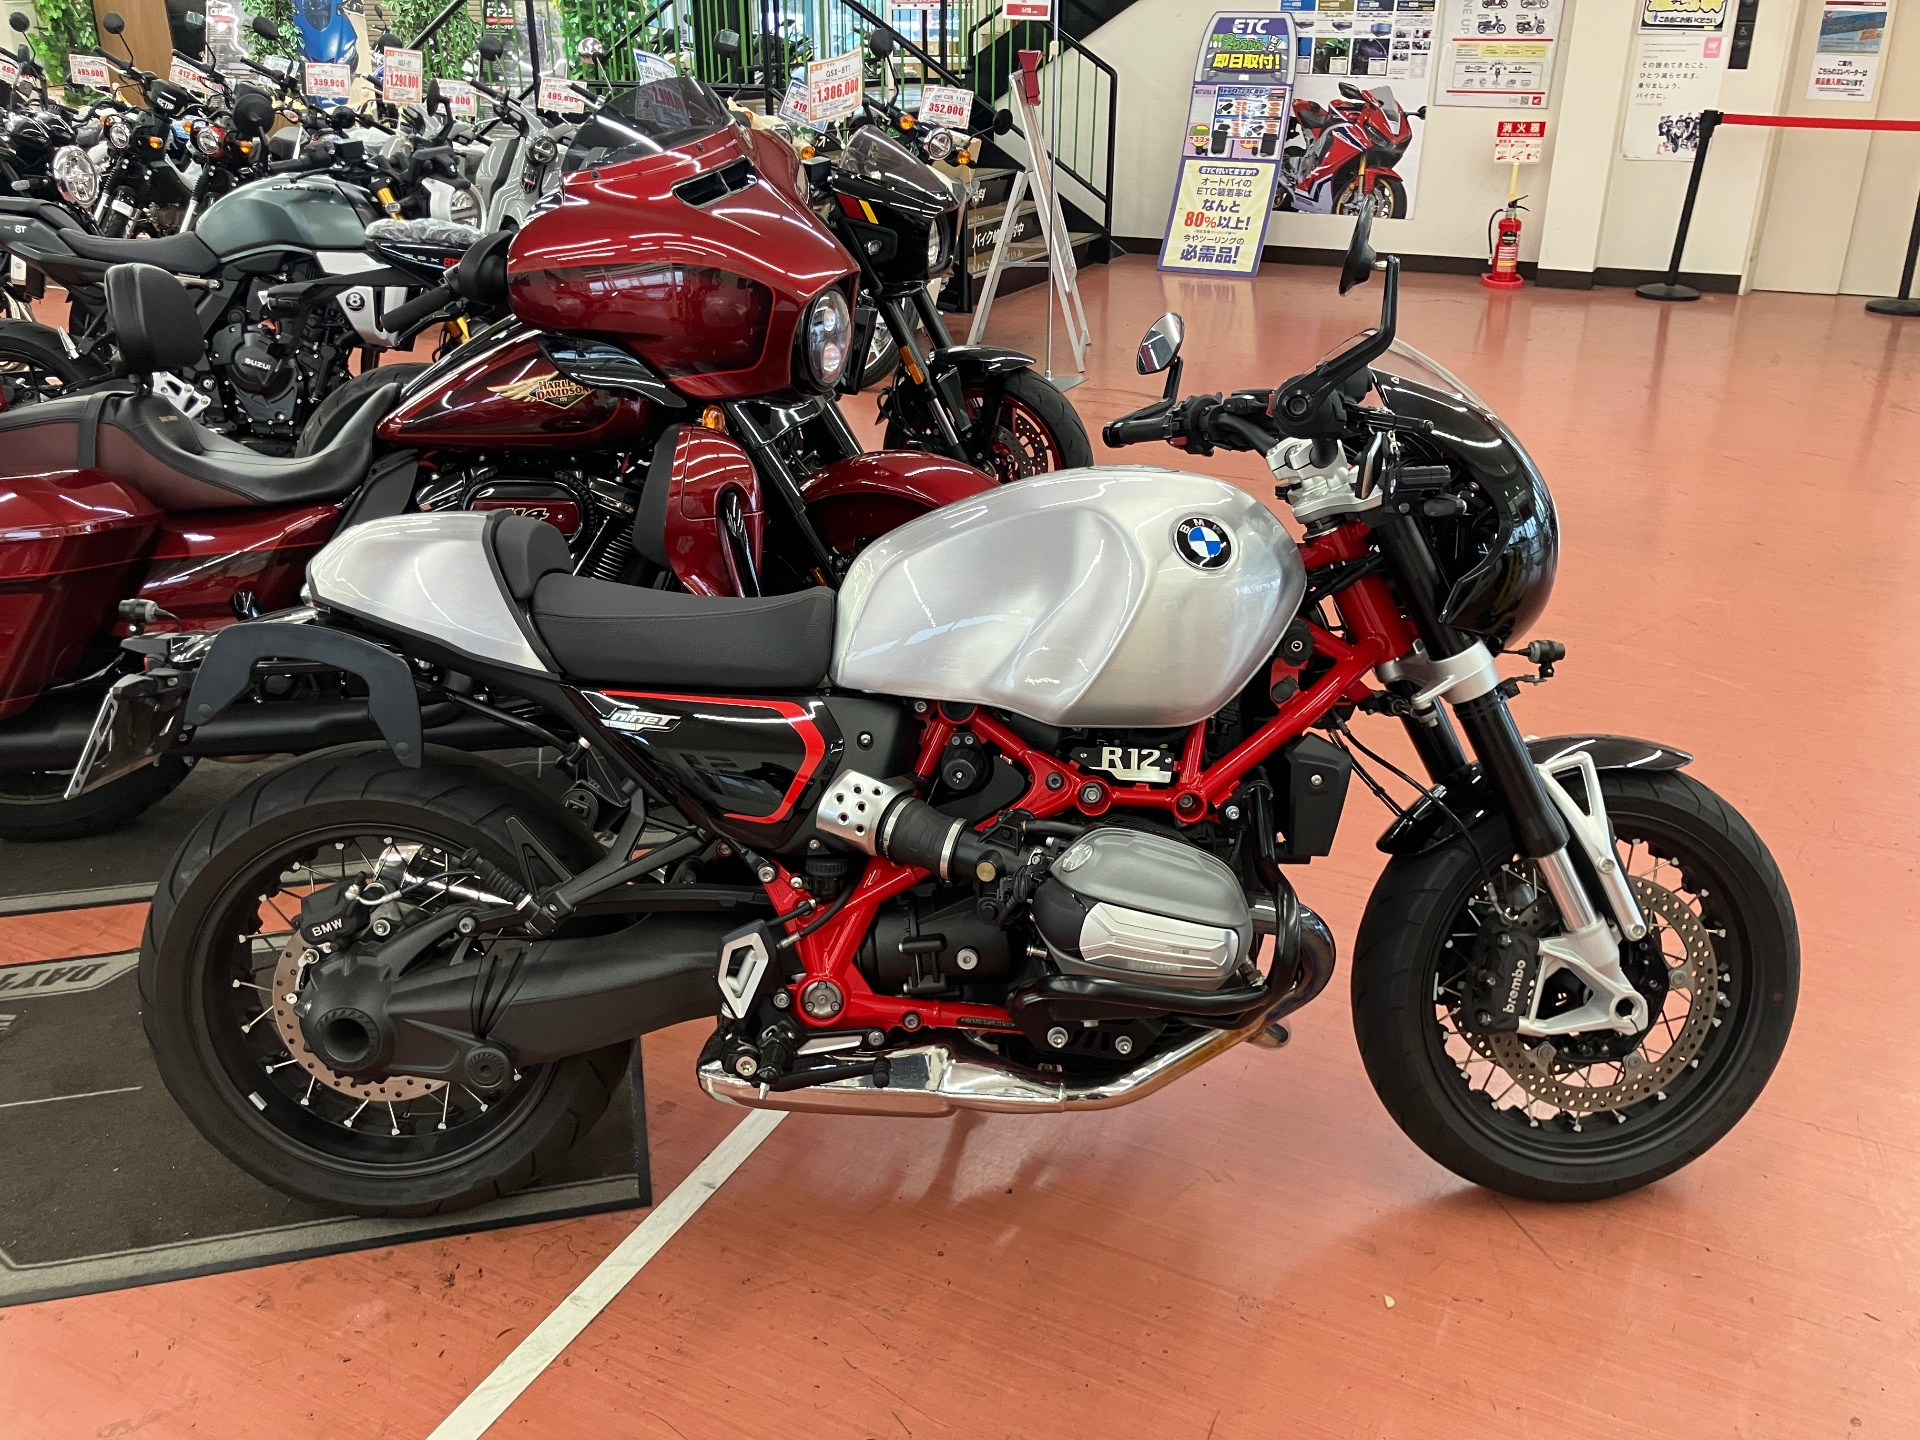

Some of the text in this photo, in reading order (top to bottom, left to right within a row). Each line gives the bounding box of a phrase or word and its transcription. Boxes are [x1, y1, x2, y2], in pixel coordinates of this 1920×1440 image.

[1232, 18, 1270, 34] ETC
[1212, 53, 1280, 70] 即日取付!
[817, 77, 859, 104] 1,386,000
[929, 103, 965, 117] 352,000
[1502, 122, 1541, 133] 消火器
[1201, 177, 1252, 188] オートバイの
[1196, 187, 1252, 198] ETC装着率は
[1202, 199, 1240, 213] なんと
[1184, 211, 1251, 231] 80%以上!
[1183, 234, 1245, 246] 今やツーリングの
[1180, 243, 1240, 265] 必需品!
[536, 386, 591, 401] DAVIDSON
[1179, 518, 1223, 535] BMW
[312, 918, 343, 937] BMW
[1502, 959, 1527, 1014] brembo
